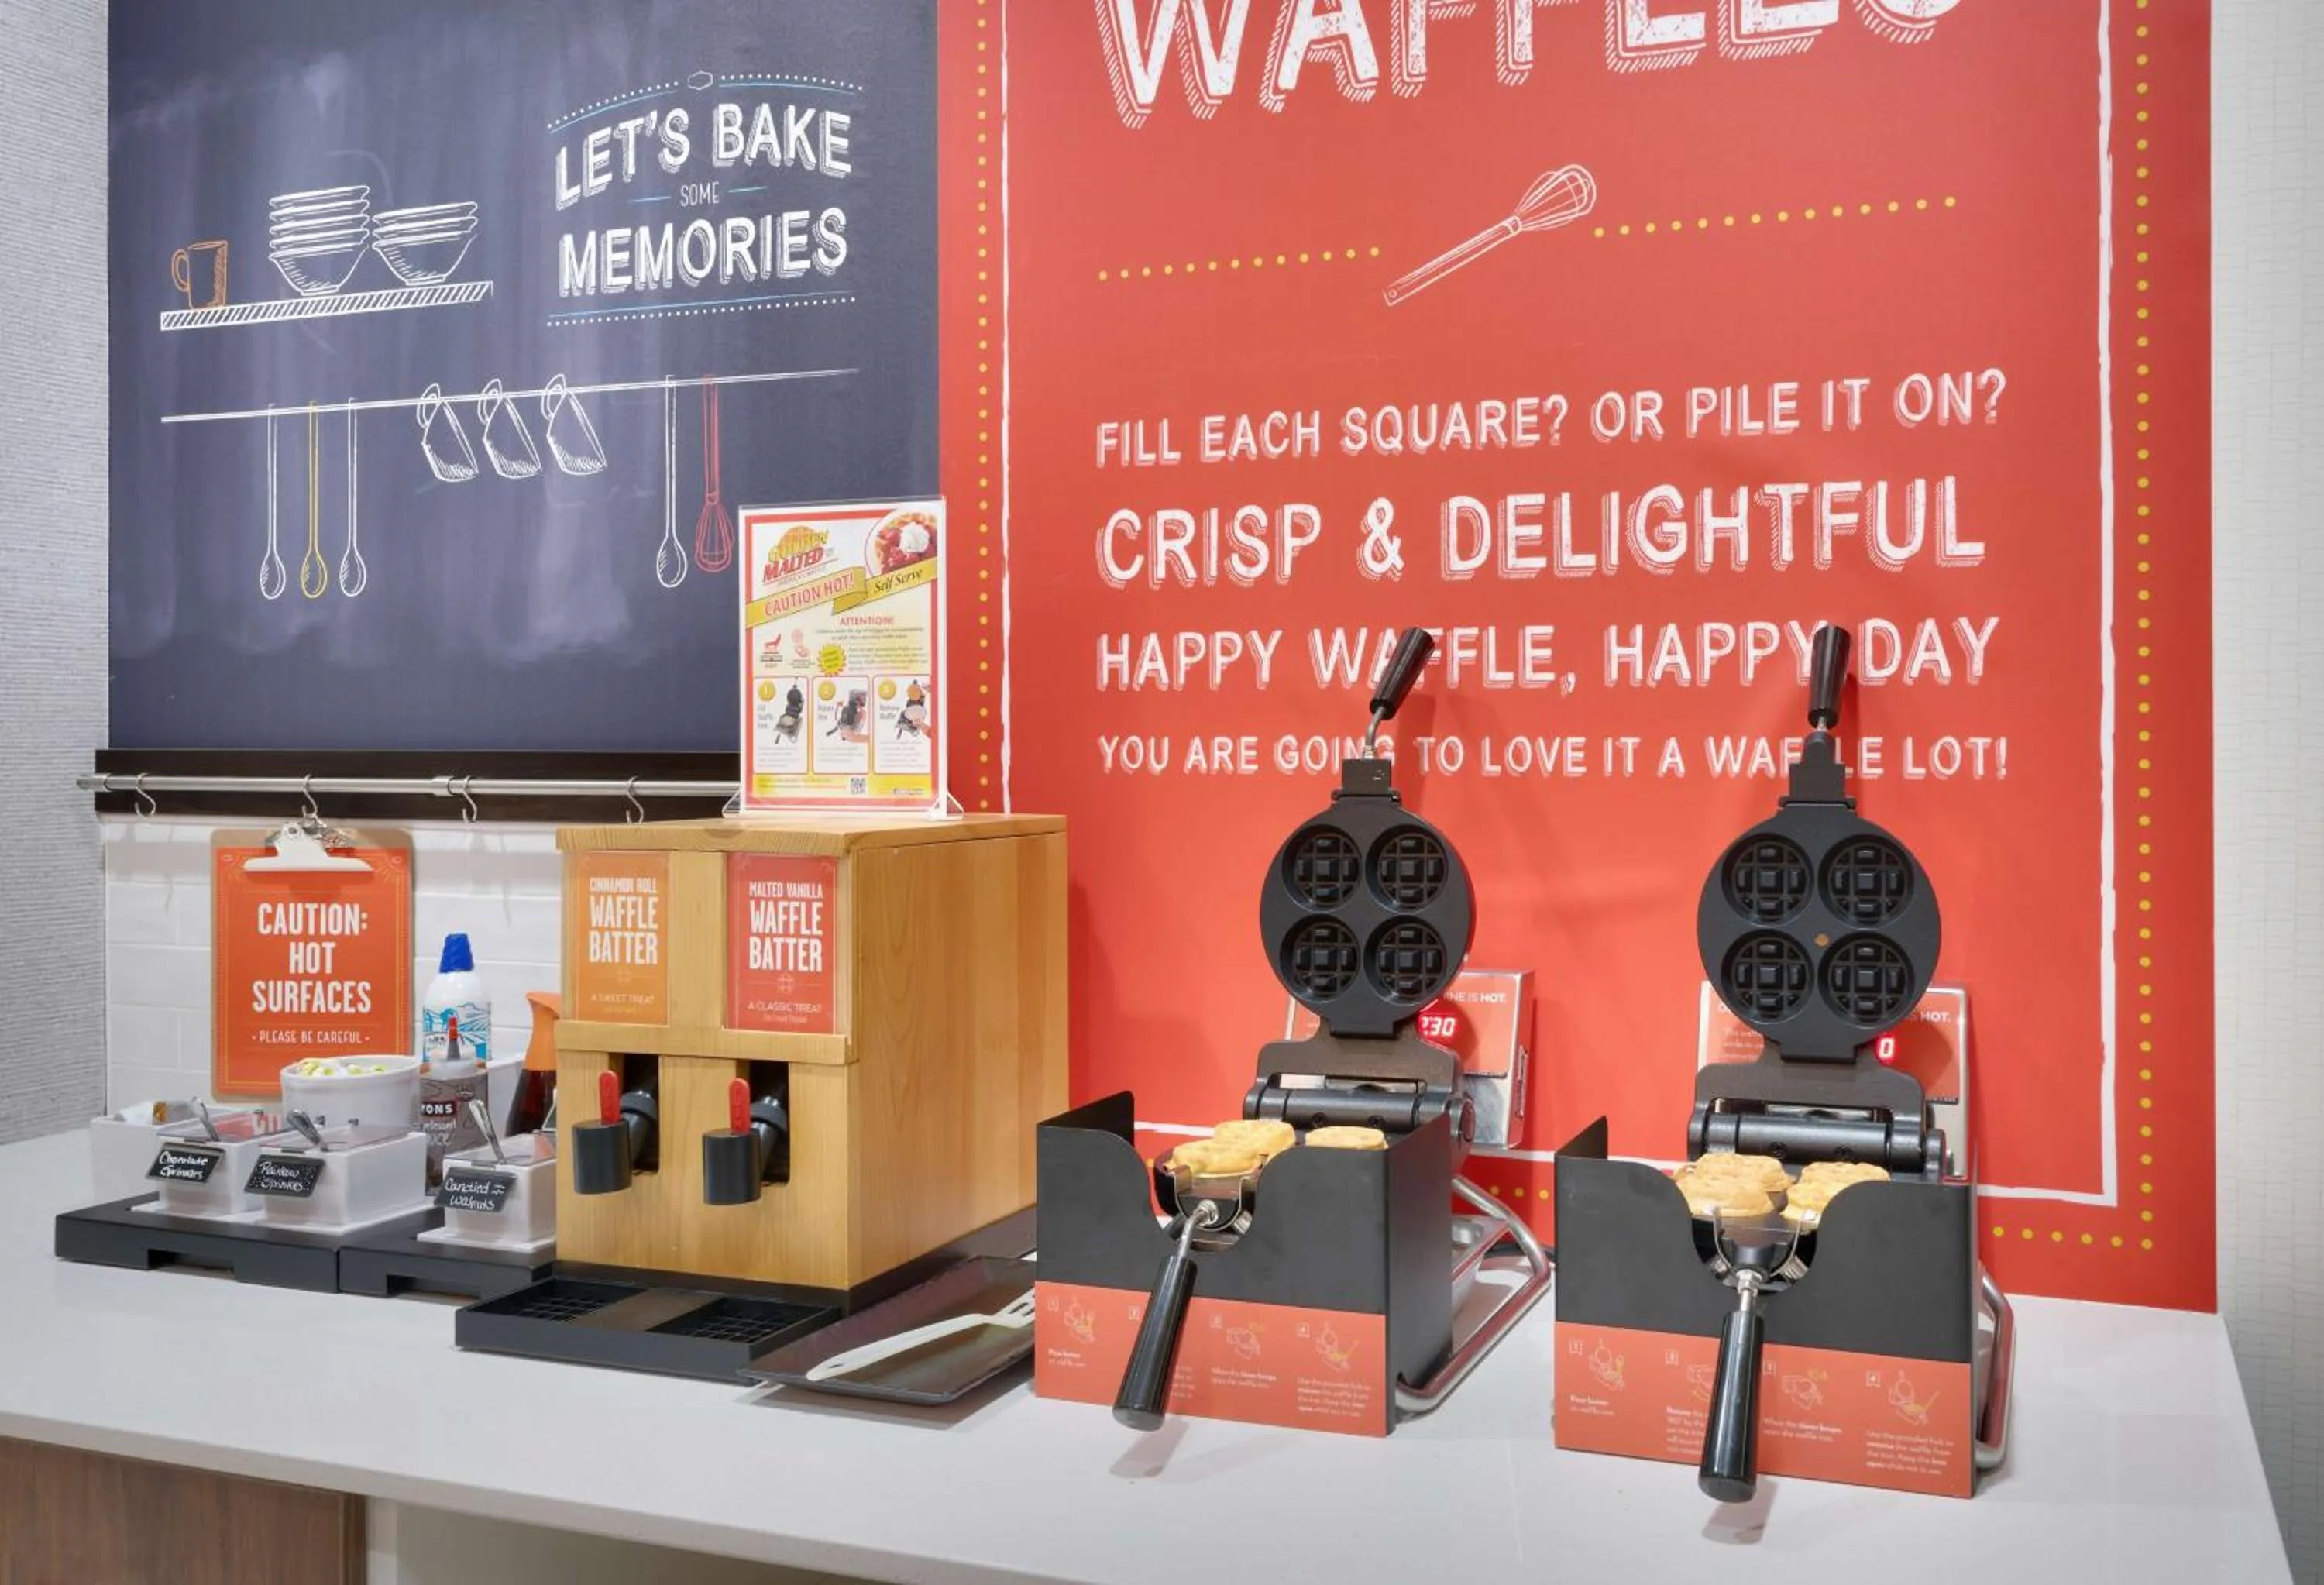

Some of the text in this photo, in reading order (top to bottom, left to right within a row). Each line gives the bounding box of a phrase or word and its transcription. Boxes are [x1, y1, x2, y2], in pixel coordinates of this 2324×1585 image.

[556, 102, 852, 211] LET'S BAKE
[680, 181, 720, 208] SOME
[559, 207, 847, 297] MEMORIES
[1096, 367, 2006, 468] FILL EACH SQUARE? OR PILE IT ON?
[1095, 476, 1986, 589] CRISP & DELIGHTFUL
[764, 586, 822, 617] CAUTION
[823, 572, 855, 600] HOT!
[1096, 629, 1283, 692] HAPPY
[1604, 619, 1829, 688] HAPPY
[1858, 617, 1999, 686] DAY
[1098, 735, 1170, 775] YOU
[1183, 735, 1259, 775] ARE
[1412, 734, 1464, 777] TO
[1480, 735, 1587, 777] LOVE
[1603, 736, 1642, 777] IT
[1657, 736, 1686, 777] A
[1706, 735, 1885, 779] WAFLE
[1903, 736, 2009, 780] LOT!
[749, 881, 823, 899] MALTED VANILLA
[257, 903, 368, 936] CAUTION:
[590, 896, 659, 930] WAFFLE
[749, 900, 823, 936] WAFFLE
[289, 941, 335, 975] HOT
[589, 931, 658, 965] BATTER
[749, 936, 823, 972] BATTER
[252, 980, 372, 1013] SURFACES
[260, 1030, 362, 1043] PLEASE BE CAREFUL
